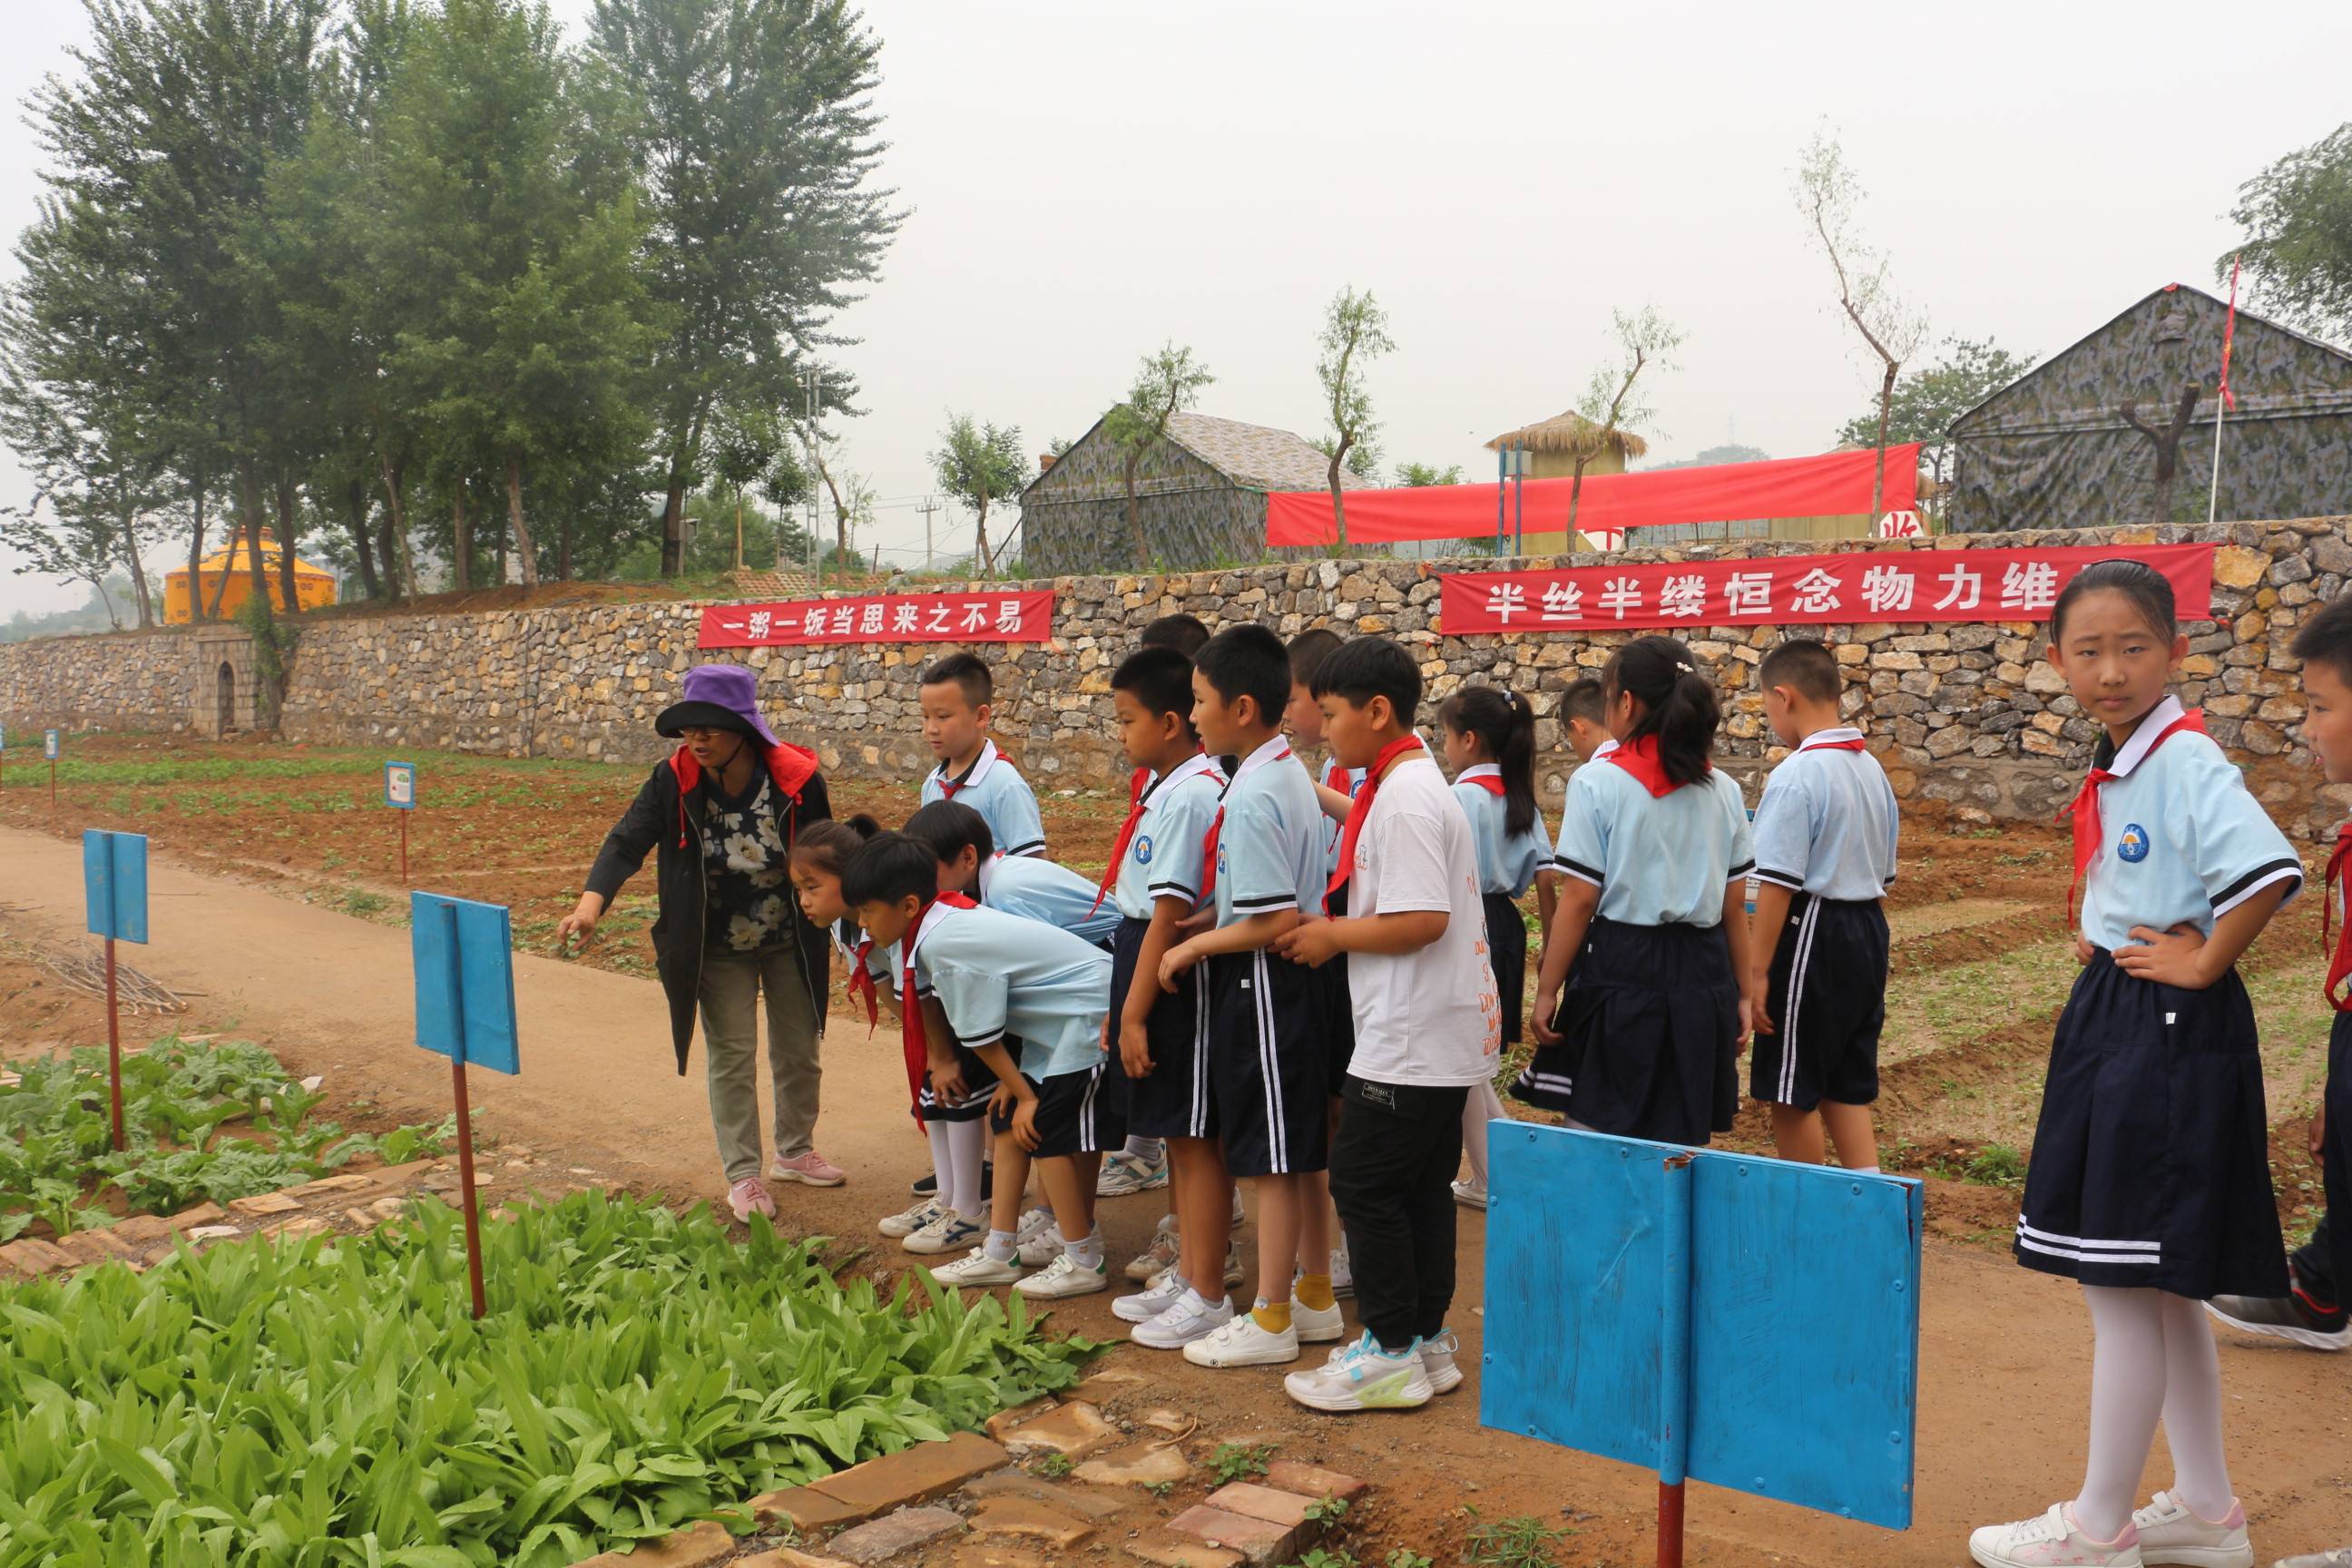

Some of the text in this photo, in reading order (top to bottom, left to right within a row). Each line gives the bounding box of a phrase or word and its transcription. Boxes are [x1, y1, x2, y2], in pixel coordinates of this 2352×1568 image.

[1485, 562, 2091, 624] 半丝半缕恒念物力维
[721, 600, 1022, 639] 一粥一饭当思来之不易
